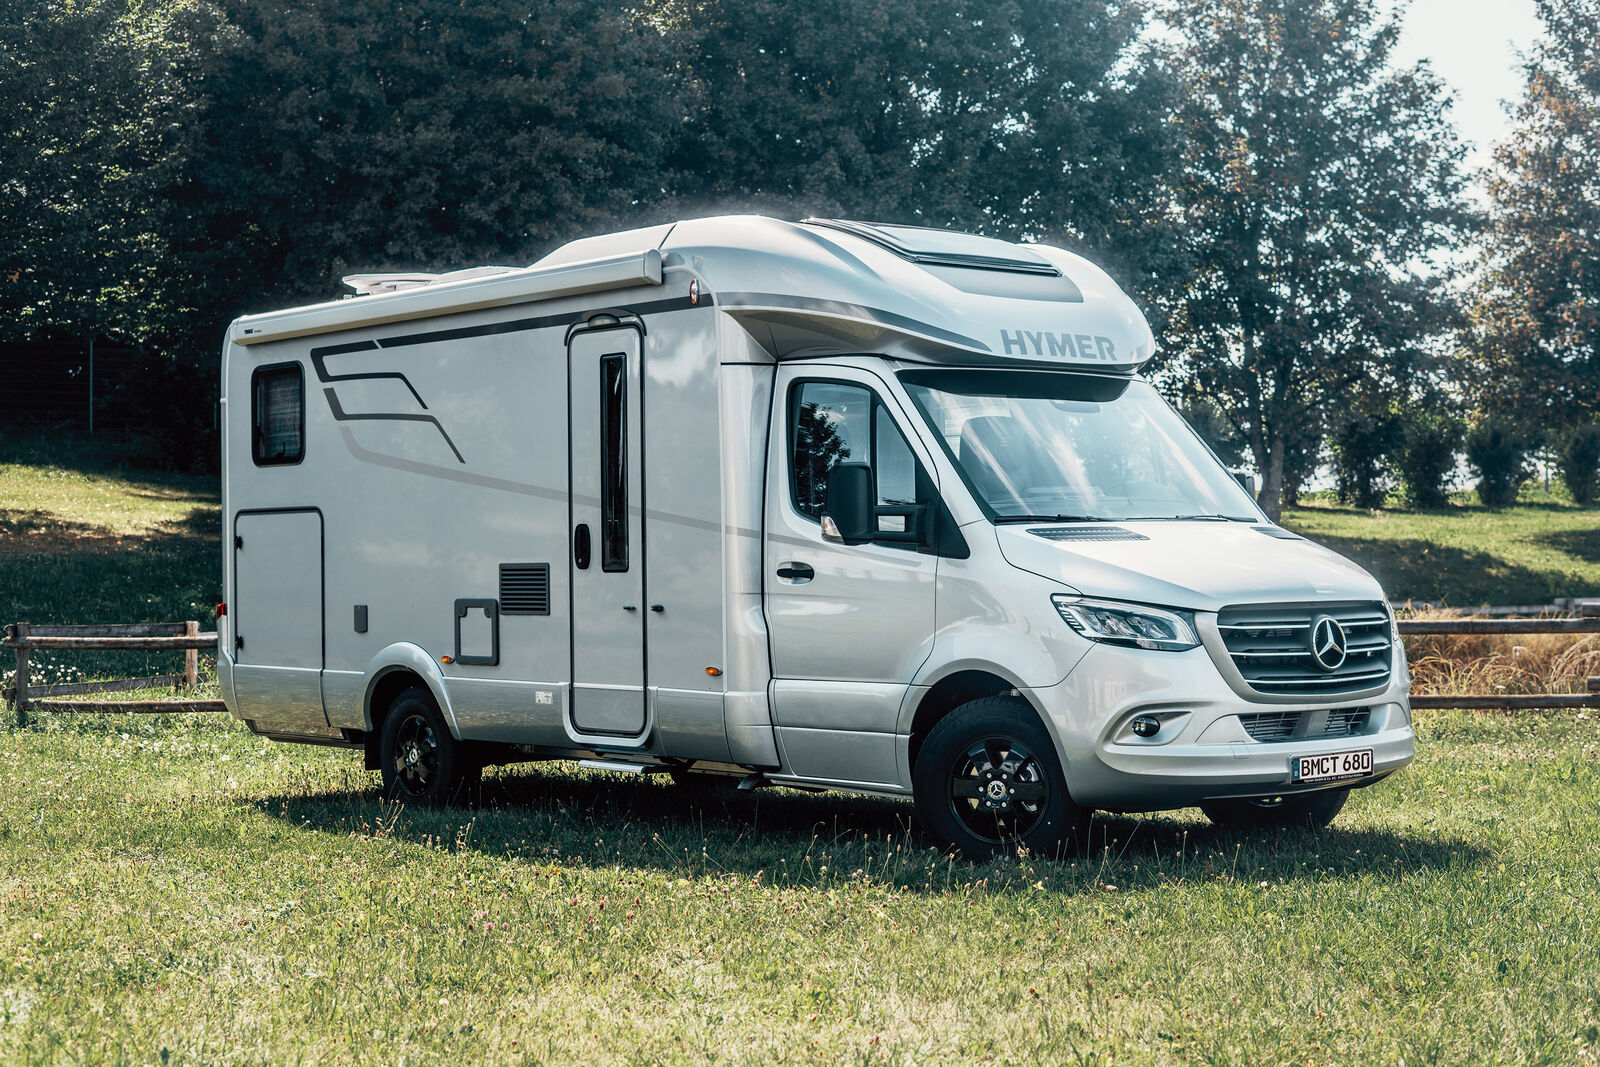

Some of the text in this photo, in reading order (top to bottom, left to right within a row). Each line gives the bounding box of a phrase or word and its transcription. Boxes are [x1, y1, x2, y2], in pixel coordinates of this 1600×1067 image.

[1000, 329, 1118, 361] HYMER
[1302, 753, 1370, 776] BMCT 680
